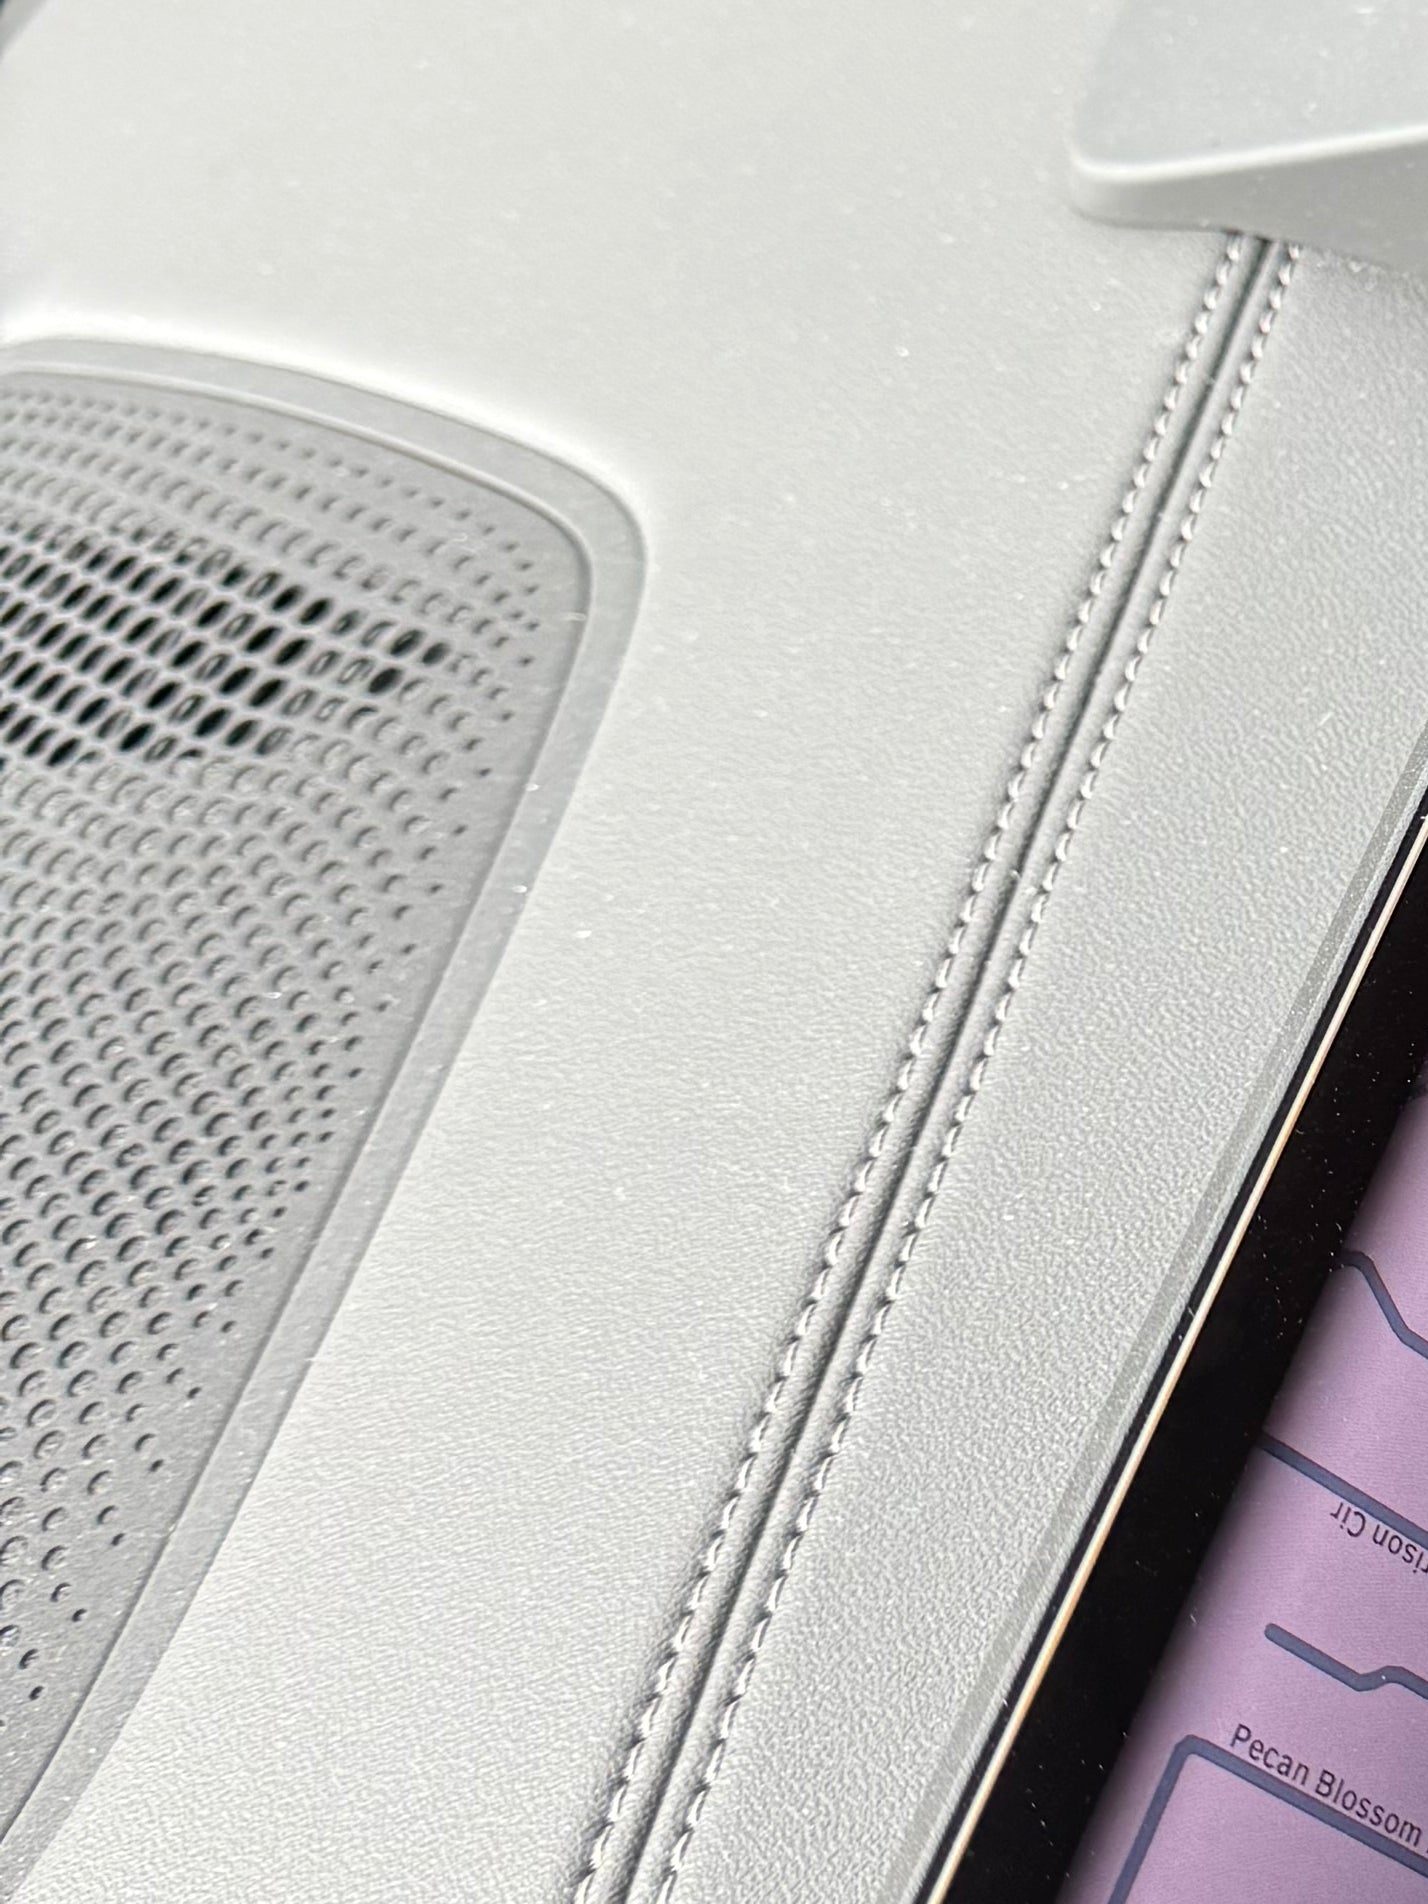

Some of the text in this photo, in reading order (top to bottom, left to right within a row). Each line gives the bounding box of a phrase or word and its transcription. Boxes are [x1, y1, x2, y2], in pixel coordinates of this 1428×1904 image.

[1329, 1502, 1366, 1538] Cir
[1229, 1722, 1310, 1786] Pecan
[1314, 1769, 1422, 1847] Blossom
